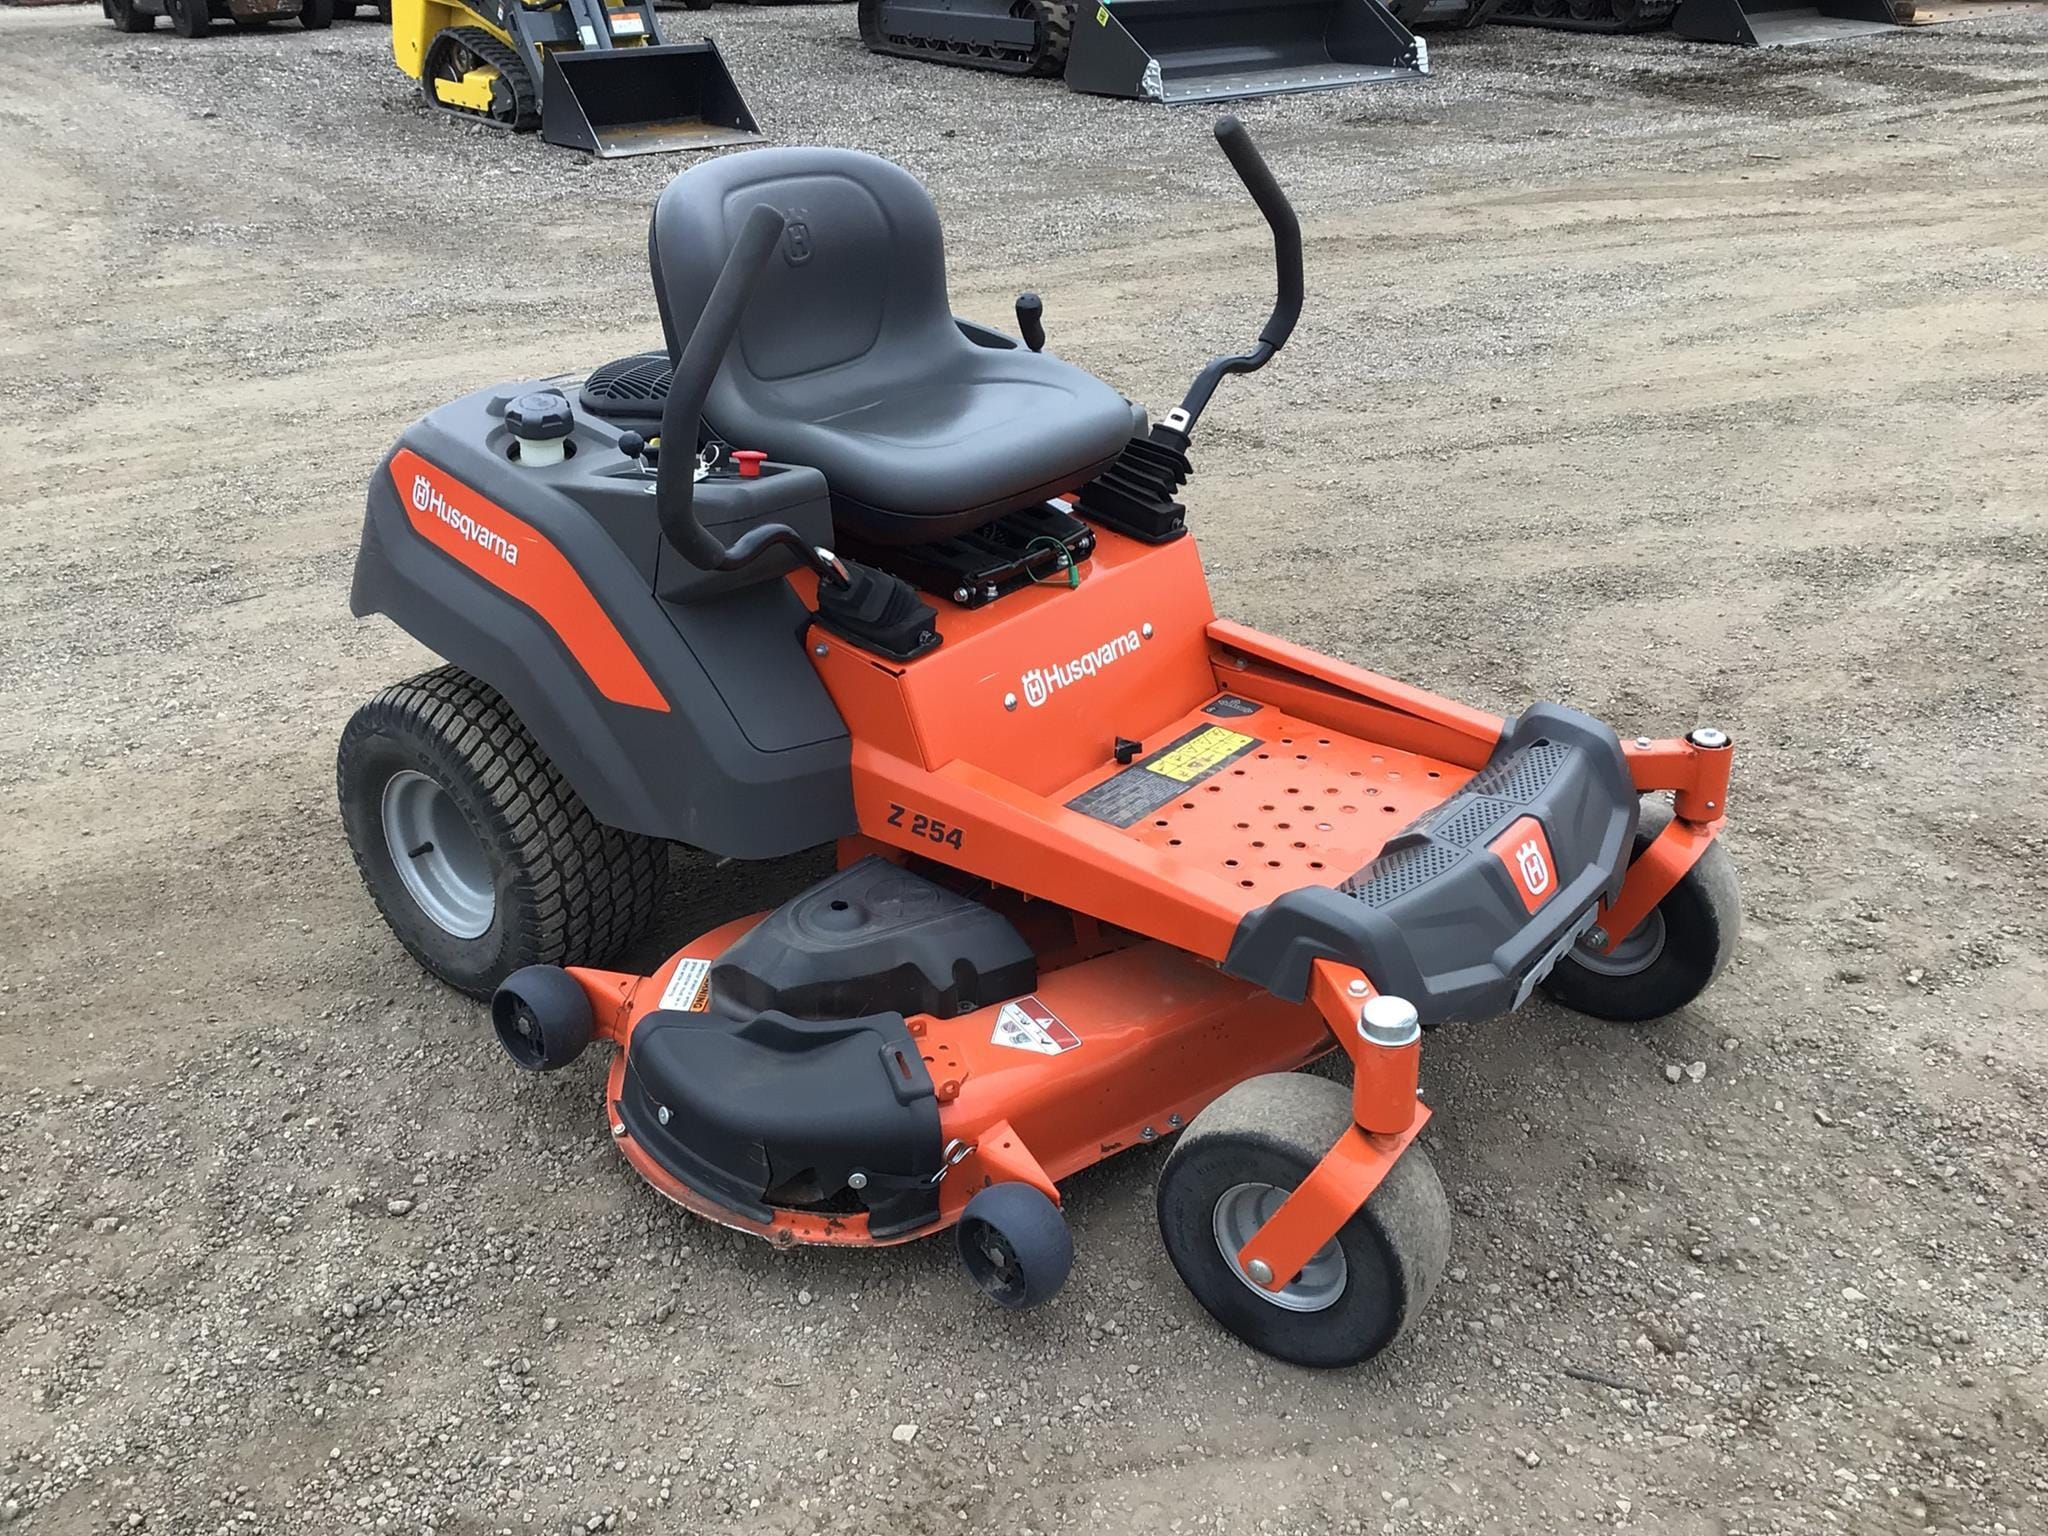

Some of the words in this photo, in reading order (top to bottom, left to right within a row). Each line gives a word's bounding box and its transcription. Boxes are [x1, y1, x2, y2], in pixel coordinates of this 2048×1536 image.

[429, 488, 518, 566] Husqvarna
[1043, 630, 1141, 694] Husqvarna
[887, 803, 905, 828] Z
[911, 814, 963, 851] 254
